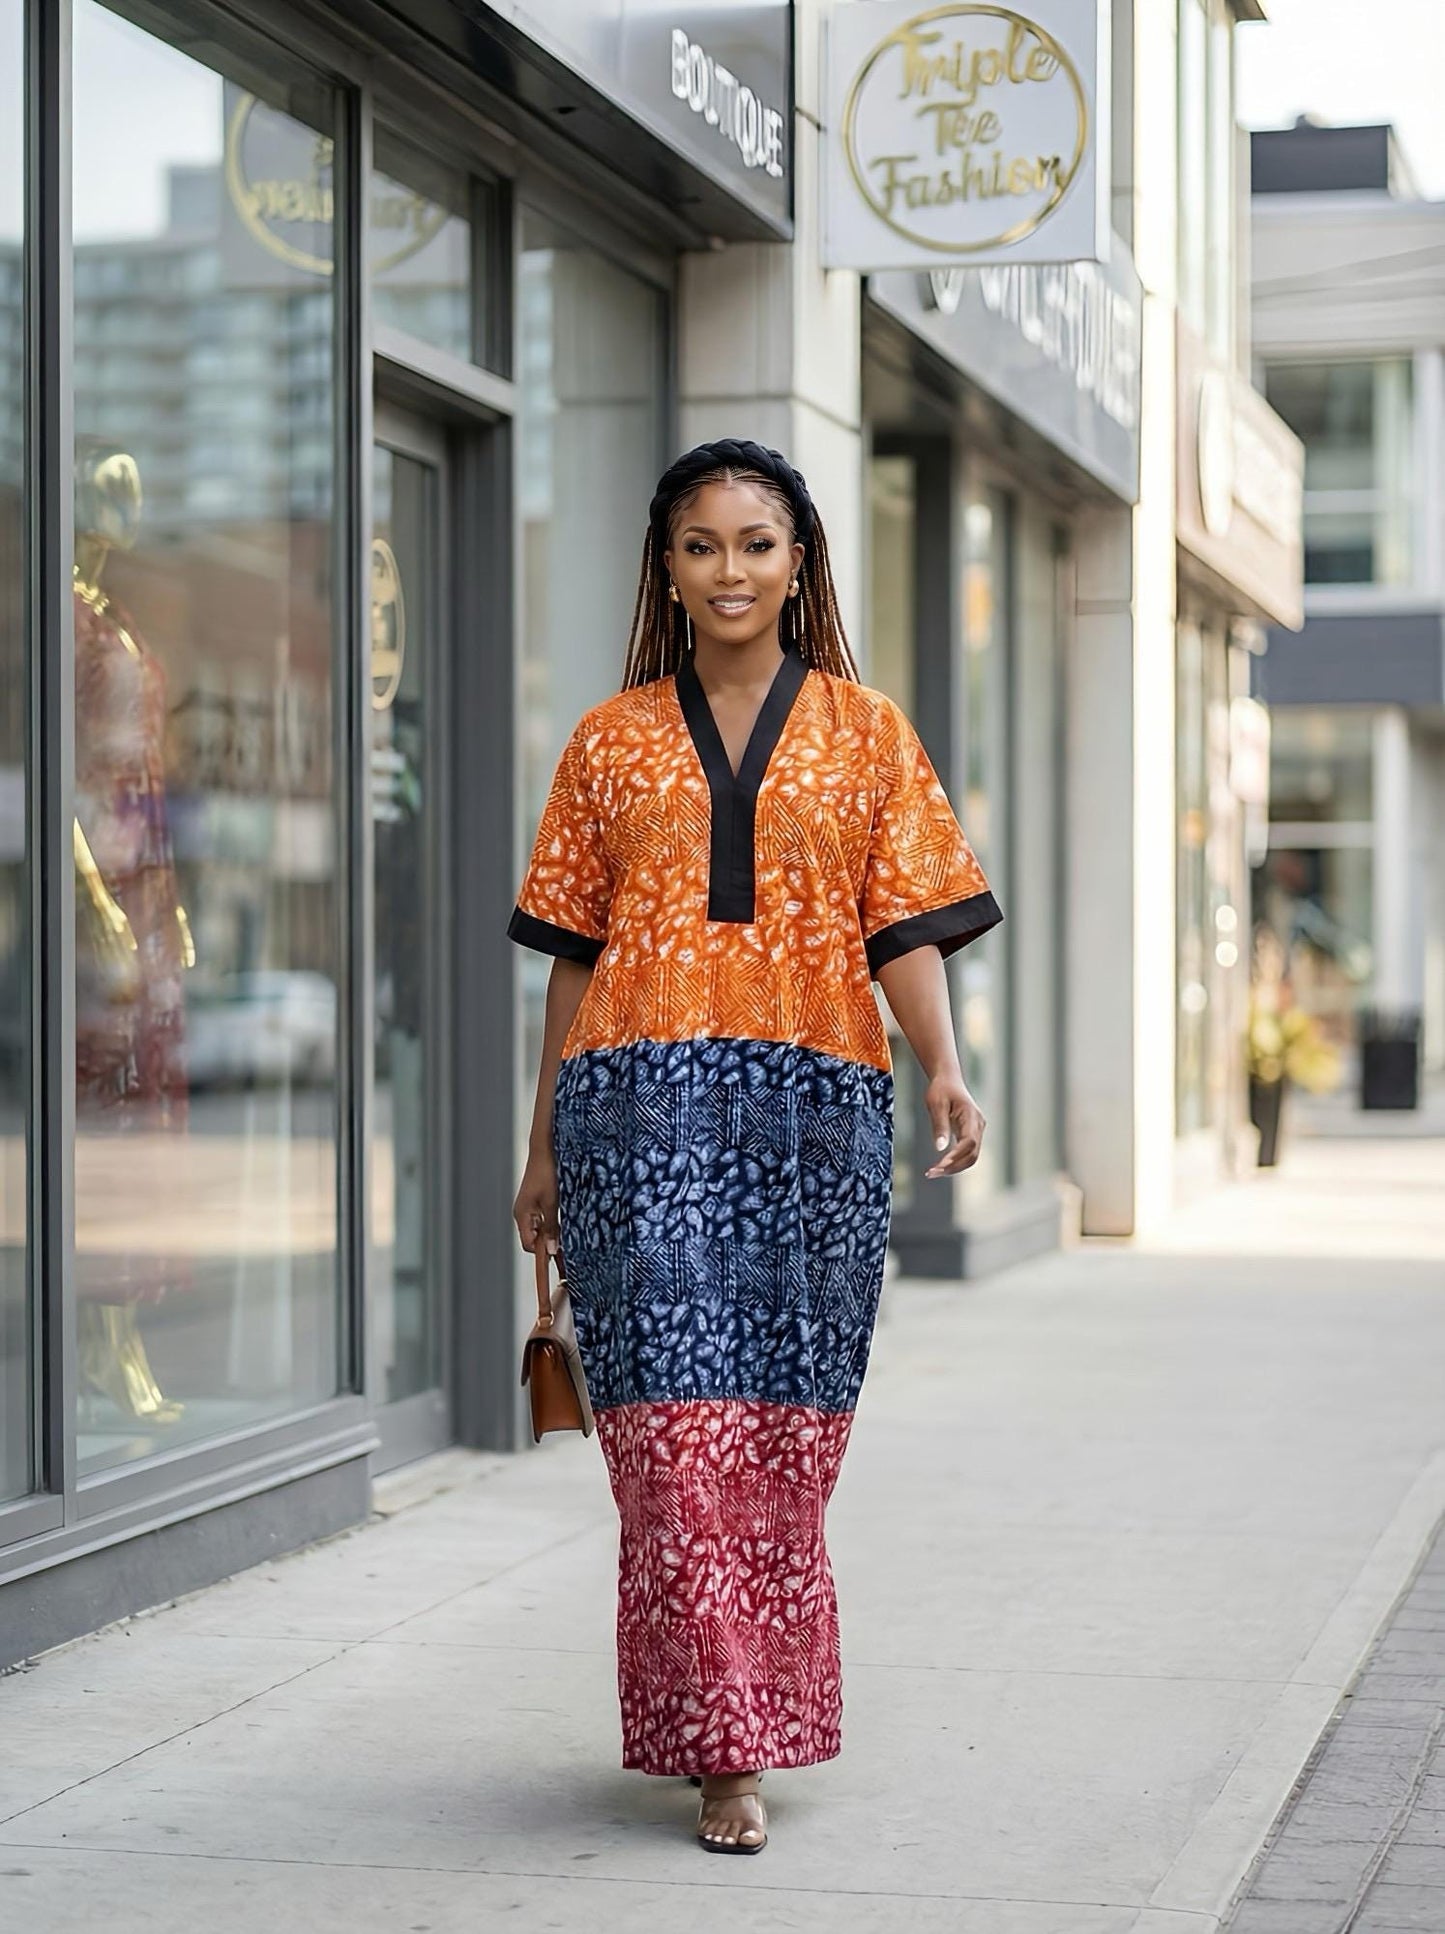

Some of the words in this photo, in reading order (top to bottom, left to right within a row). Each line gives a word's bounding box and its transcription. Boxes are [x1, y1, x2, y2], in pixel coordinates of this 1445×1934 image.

[897, 23, 1061, 101] Triple
[915, 103, 1002, 156] Tee
[869, 151, 1065, 214] Fashion
